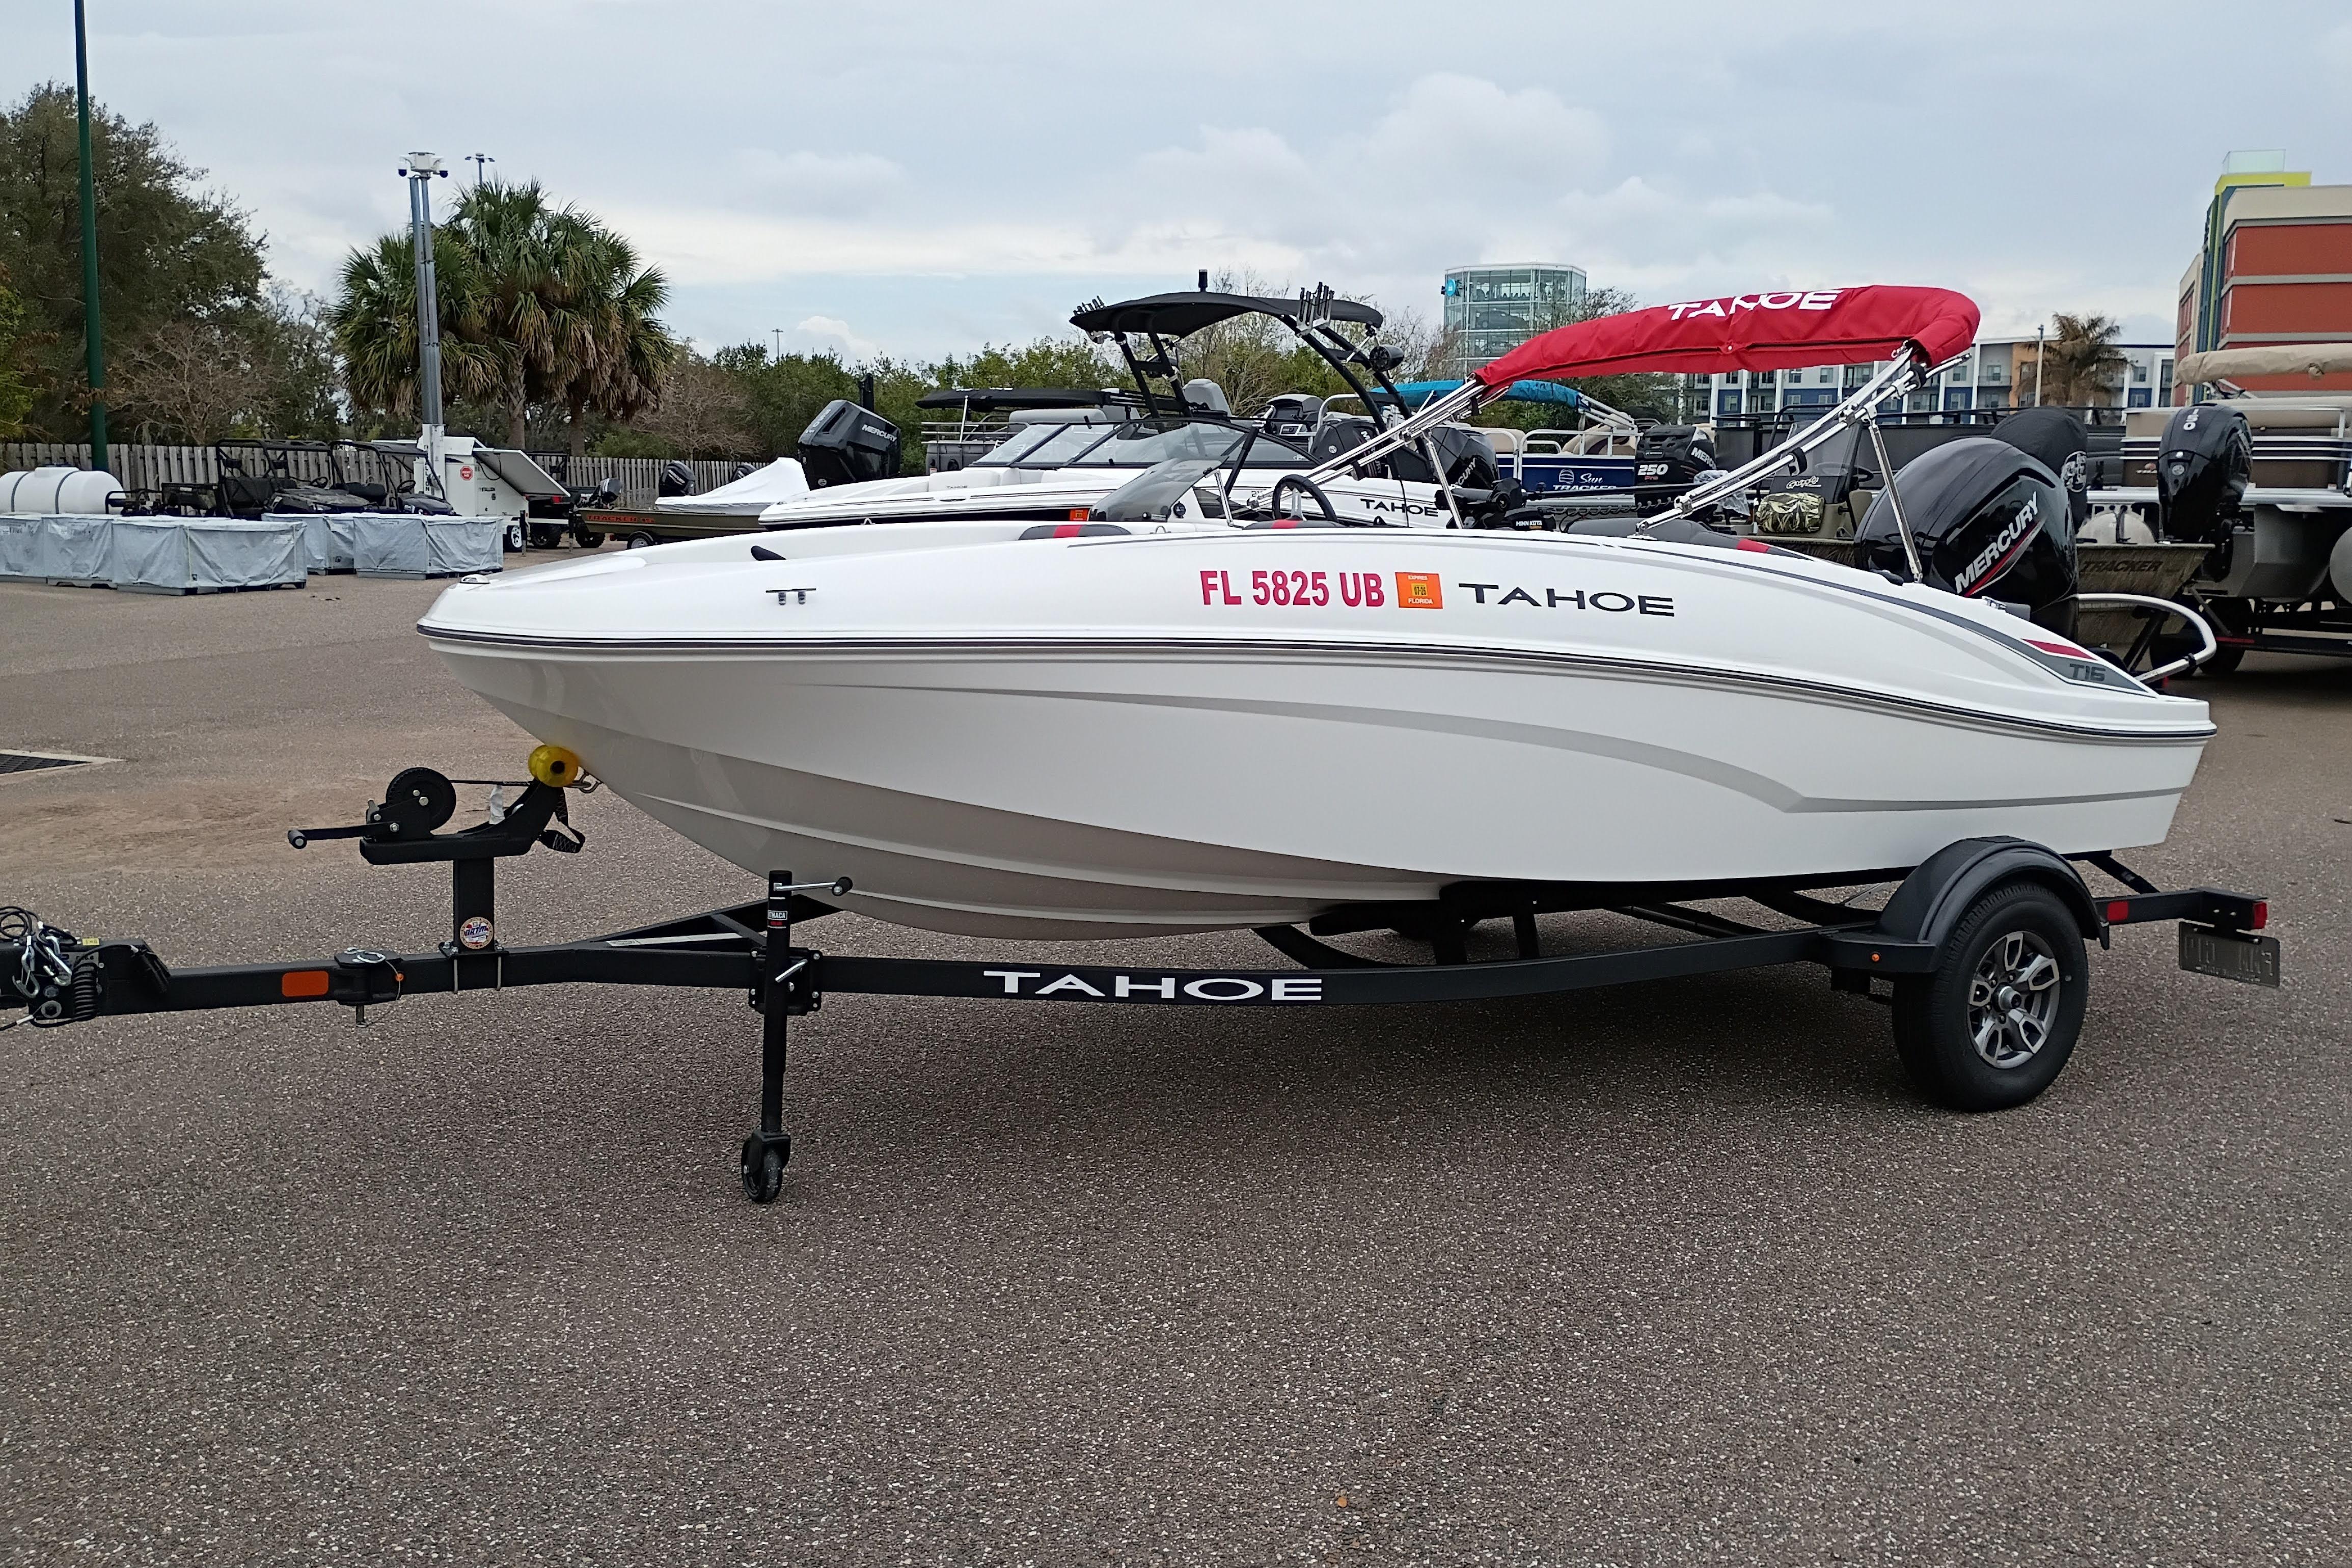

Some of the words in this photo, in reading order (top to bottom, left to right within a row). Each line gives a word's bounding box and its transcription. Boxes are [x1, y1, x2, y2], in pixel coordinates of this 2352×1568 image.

[1667, 290, 1844, 320] TAHOE
[2183, 408, 2201, 431] 150
[862, 424, 897, 442] MERCURY
[1579, 473, 1604, 483] Sun
[1637, 464, 1669, 476] 250
[1360, 499, 1438, 517] TAHOE
[1955, 491, 2038, 594] MERCURY
[2079, 561, 2163, 572] TRACKER
[1200, 570, 1242, 605] FL
[1252, 571, 1329, 606] 5825
[1339, 572, 1384, 607] UB
[1459, 583, 1674, 617] TAHOE
[2069, 663, 2106, 681] T16
[983, 970, 1322, 1000] TAHOE
